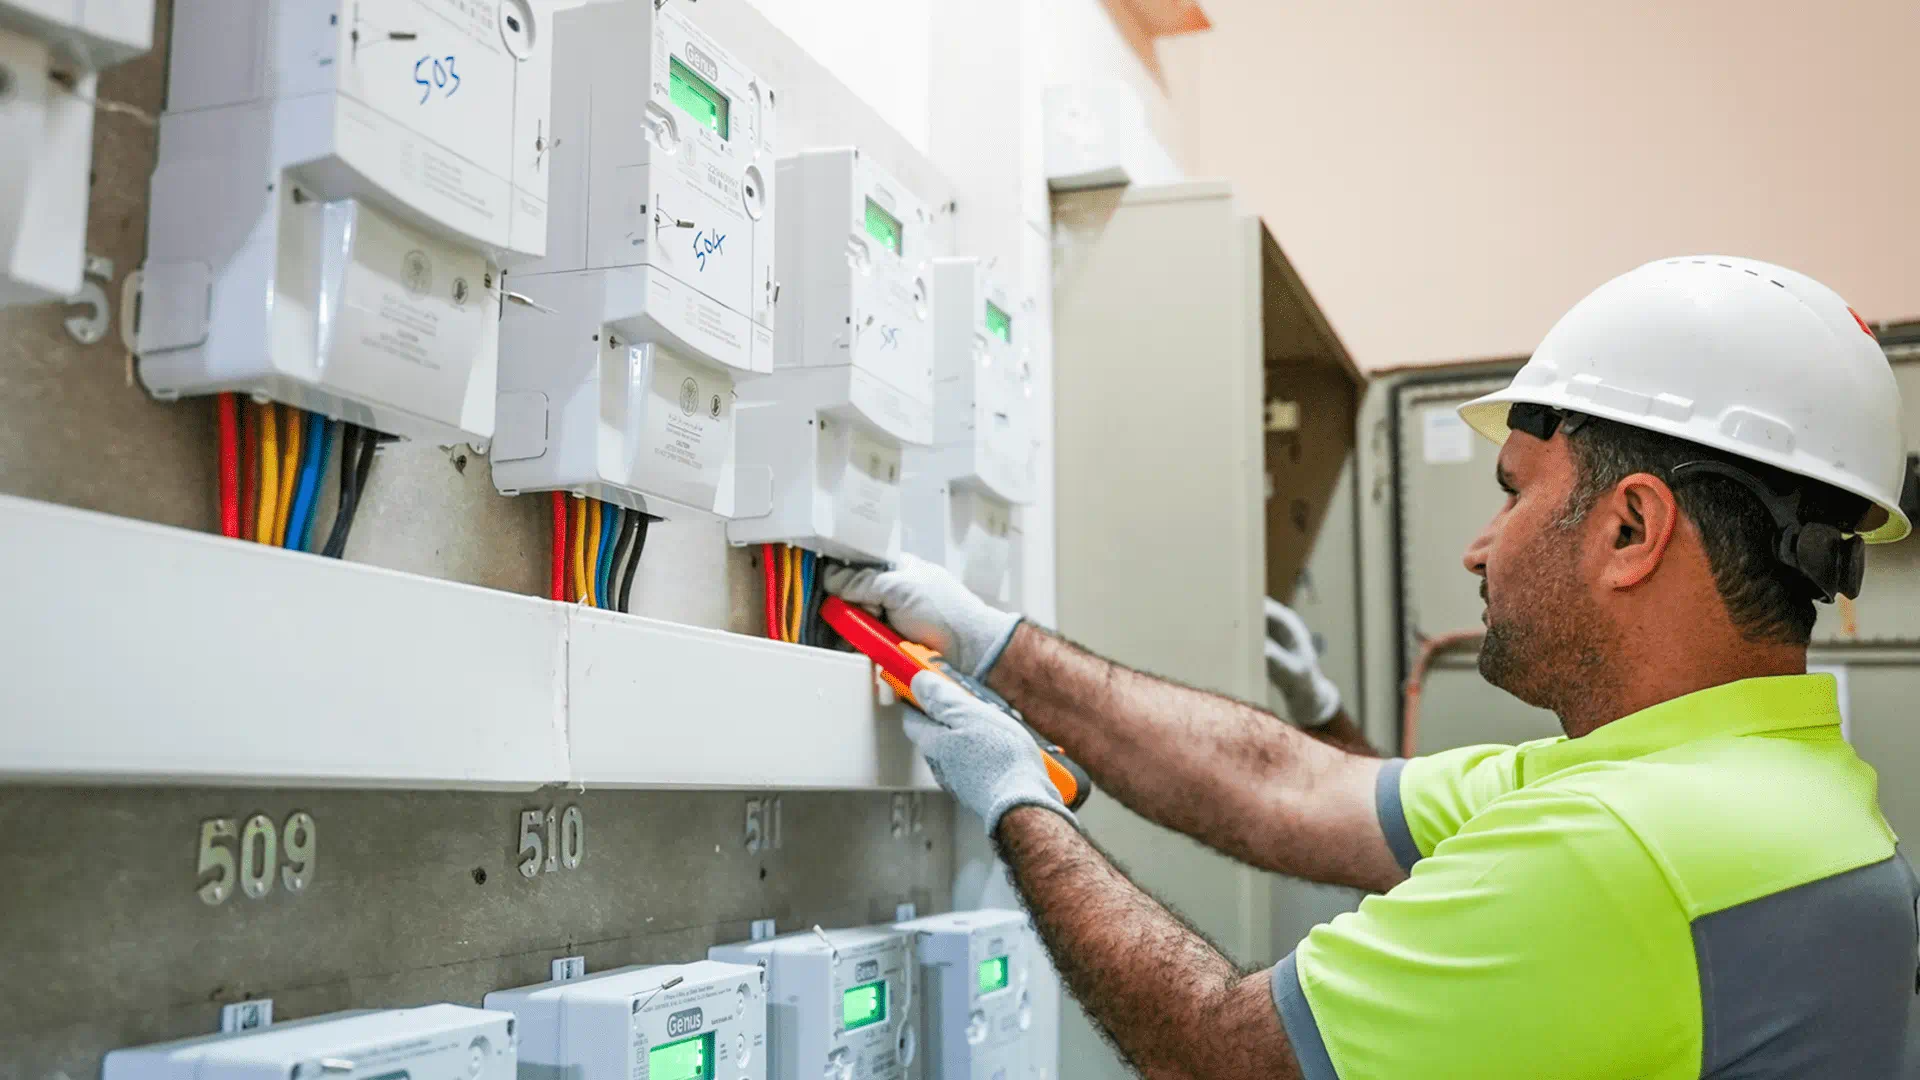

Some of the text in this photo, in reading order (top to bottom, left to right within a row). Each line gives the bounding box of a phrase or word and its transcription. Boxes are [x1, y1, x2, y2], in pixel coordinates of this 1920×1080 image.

[414, 55, 461, 105] 503
[686, 44, 717, 81] Genus
[693, 228, 726, 272] 504
[518, 805, 584, 878] 510
[745, 797, 782, 856] 511
[197, 812, 317, 906] 509
[667, 1011, 702, 1036] Genus
